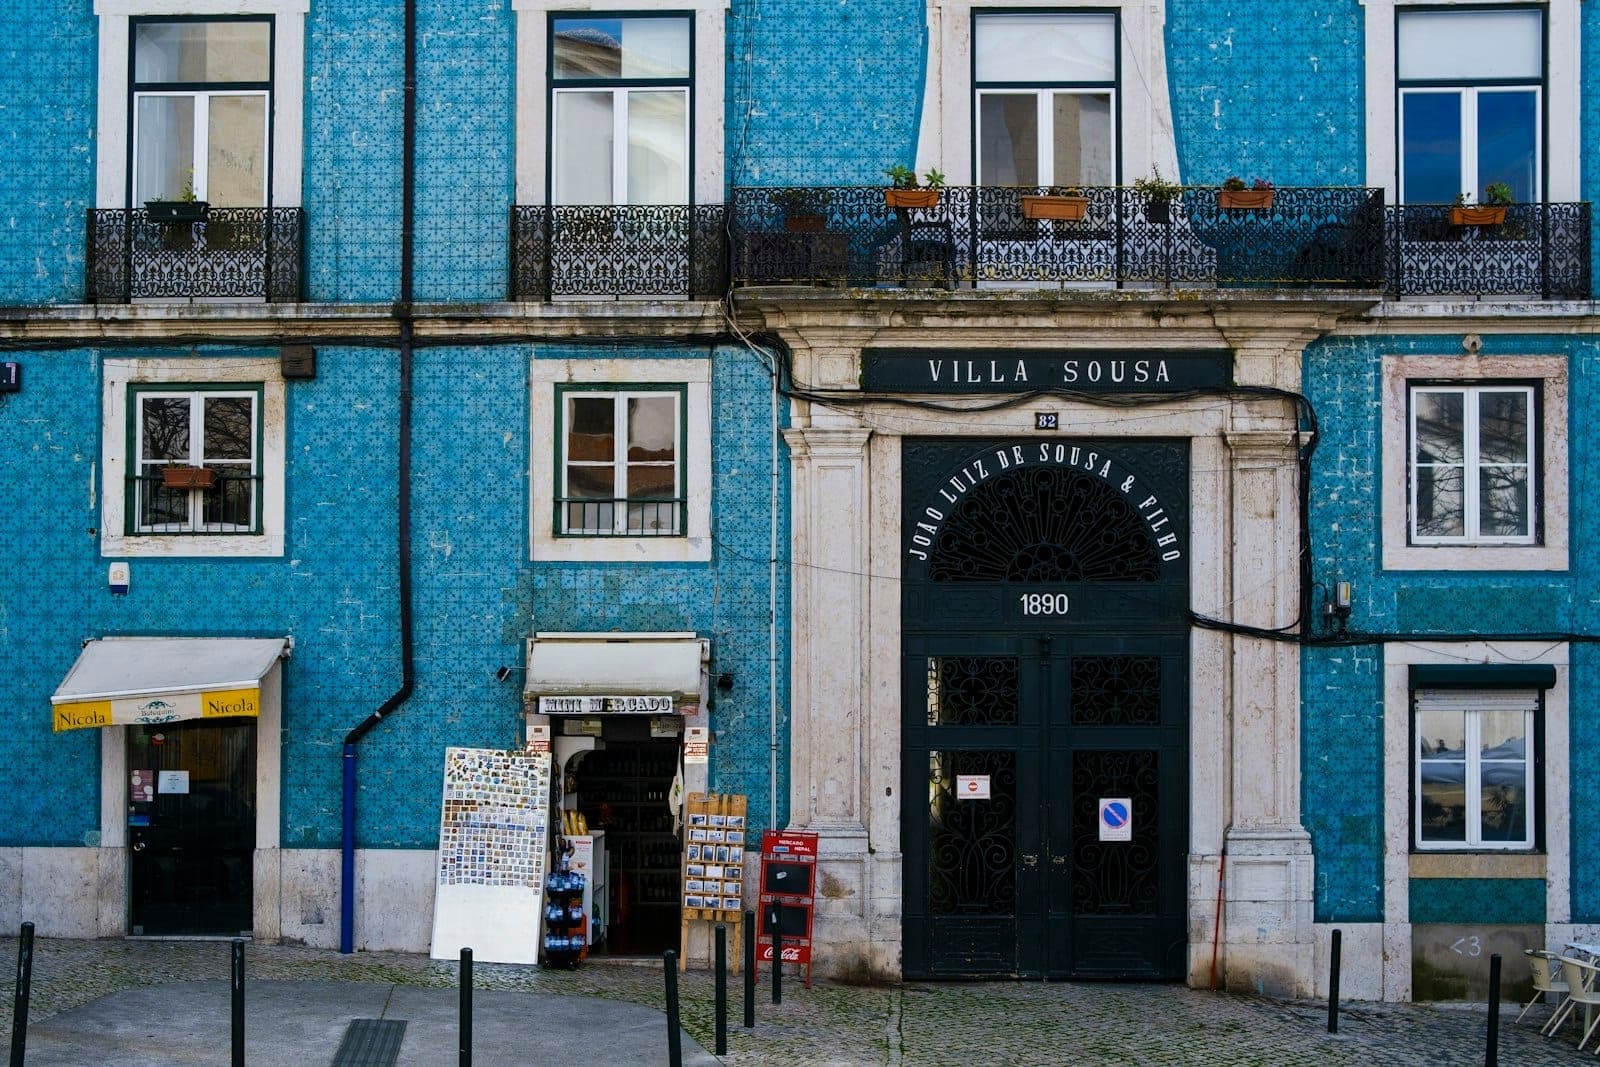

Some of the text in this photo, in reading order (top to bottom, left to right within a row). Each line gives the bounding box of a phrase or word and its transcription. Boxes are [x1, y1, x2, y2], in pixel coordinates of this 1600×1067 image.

[928, 360, 1170, 383] VILLA SOUSA
[1038, 414, 1056, 428] 82
[939, 459, 989, 504] LUIZ
[996, 445, 1025, 469] DE
[1039, 442, 1112, 478] SOUSA
[1120, 474, 1135, 494] &
[1138, 495, 1181, 562] FILHO
[1020, 593, 1069, 615] 1890
[207, 698, 254, 714] Nicola
[545, 698, 582, 712] MINI
[589, 697, 671, 713] MERCADO
[58, 711, 105, 726] Nicola
